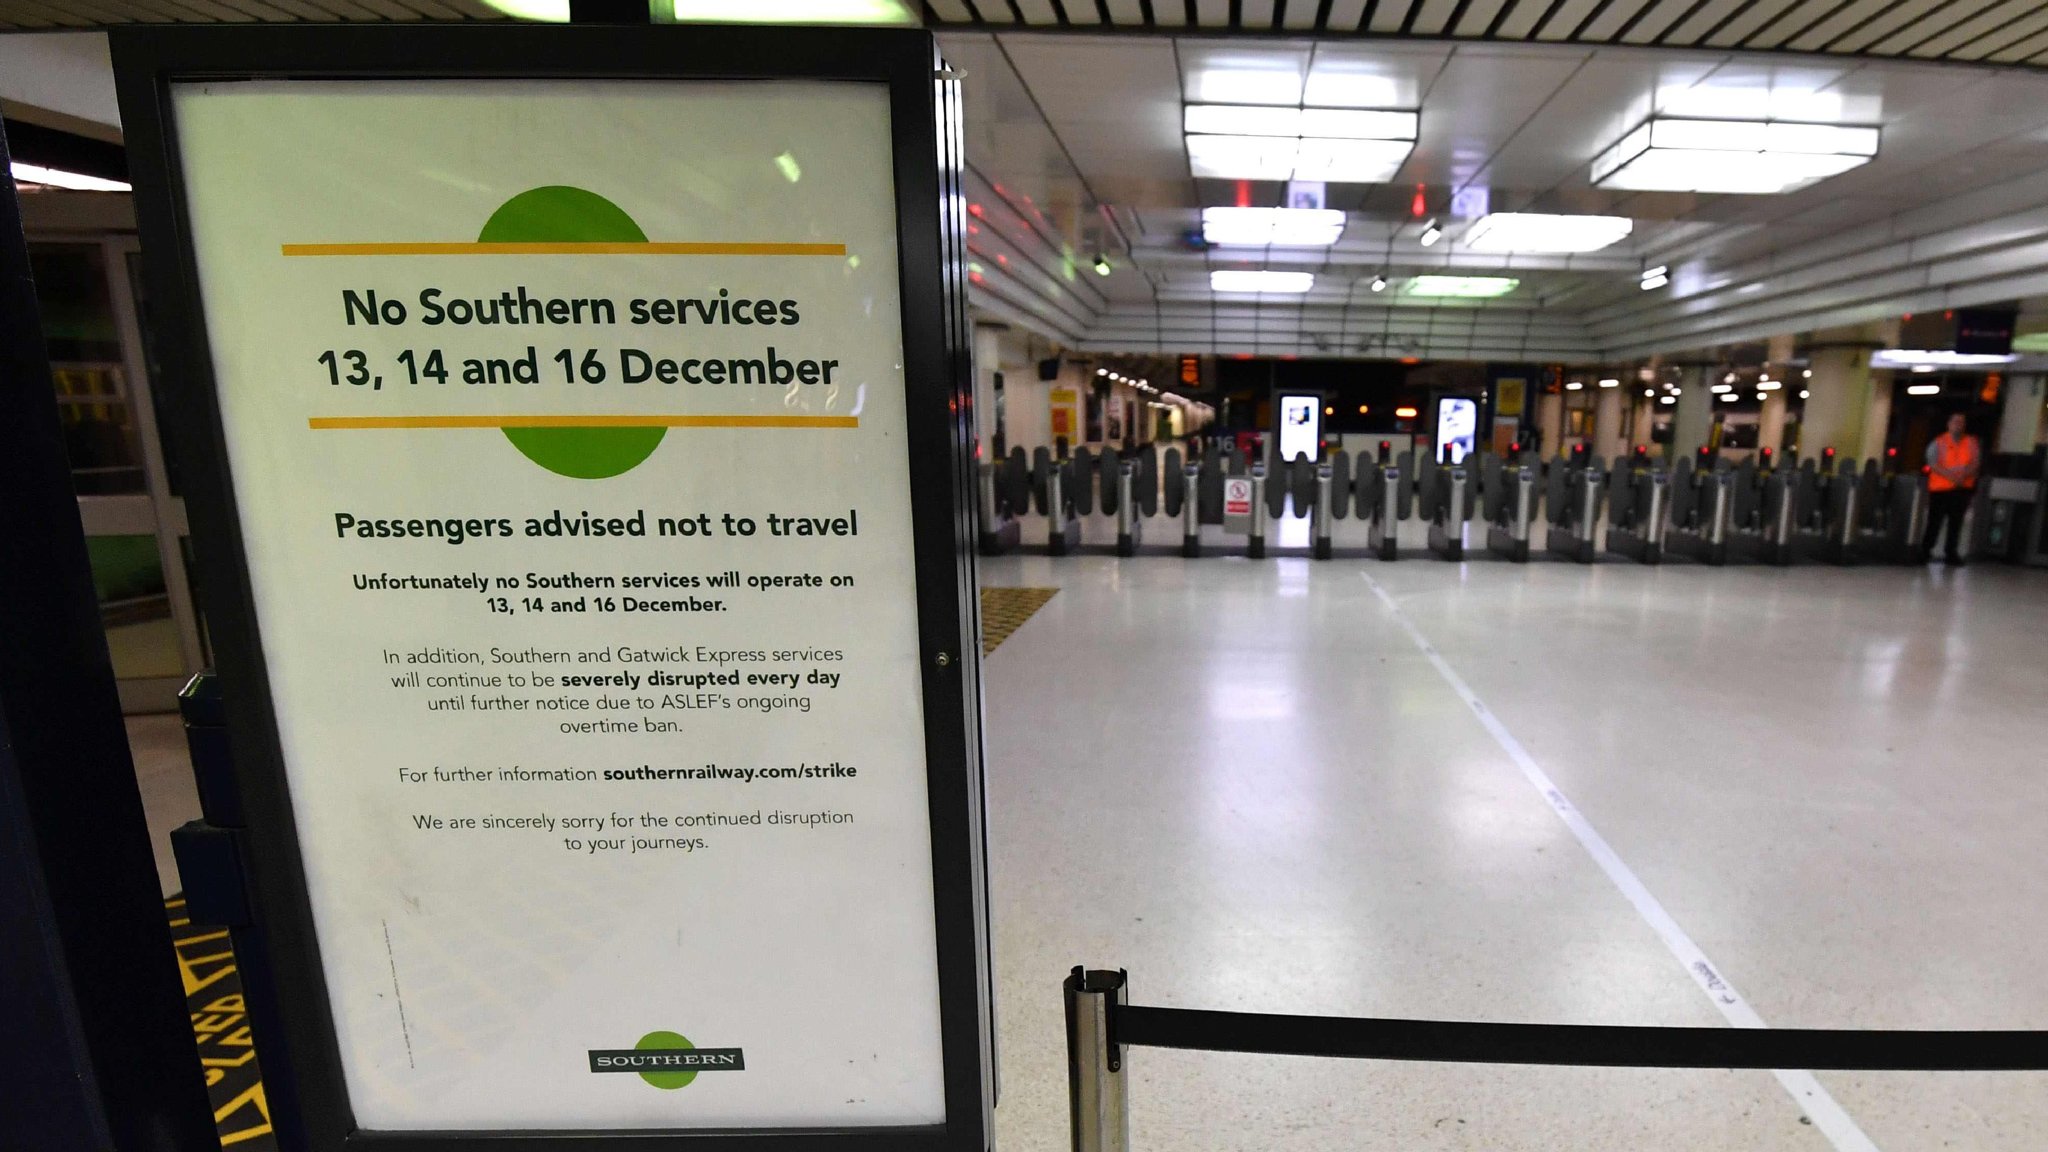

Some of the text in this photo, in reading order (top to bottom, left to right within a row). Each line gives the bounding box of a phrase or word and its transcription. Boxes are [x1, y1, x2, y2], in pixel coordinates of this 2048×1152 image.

[341, 285, 800, 326] No Southern services
[317, 345, 841, 391] 13, 14 and 16 December
[334, 508, 858, 546] Passengers advised not to travel
[352, 570, 855, 594] Unfortunately no Southern services will operate on
[485, 595, 728, 616] 13, 14 and 16 December.
[383, 645, 844, 668] In addition, Southern and Gatwick Express services
[390, 667, 841, 691] will continue to be severely disrupted every day
[427, 693, 811, 713] until further notice due to ASLEF's ongoing
[559, 716, 683, 734] overtime ban.
[398, 761, 858, 784] For further information southernrailway.com/strike
[412, 809, 854, 833] We are sincerely sorry for the continued disruption
[563, 835, 709, 855] to your journeys.
[597, 1054, 736, 1067] SOUTHERN
